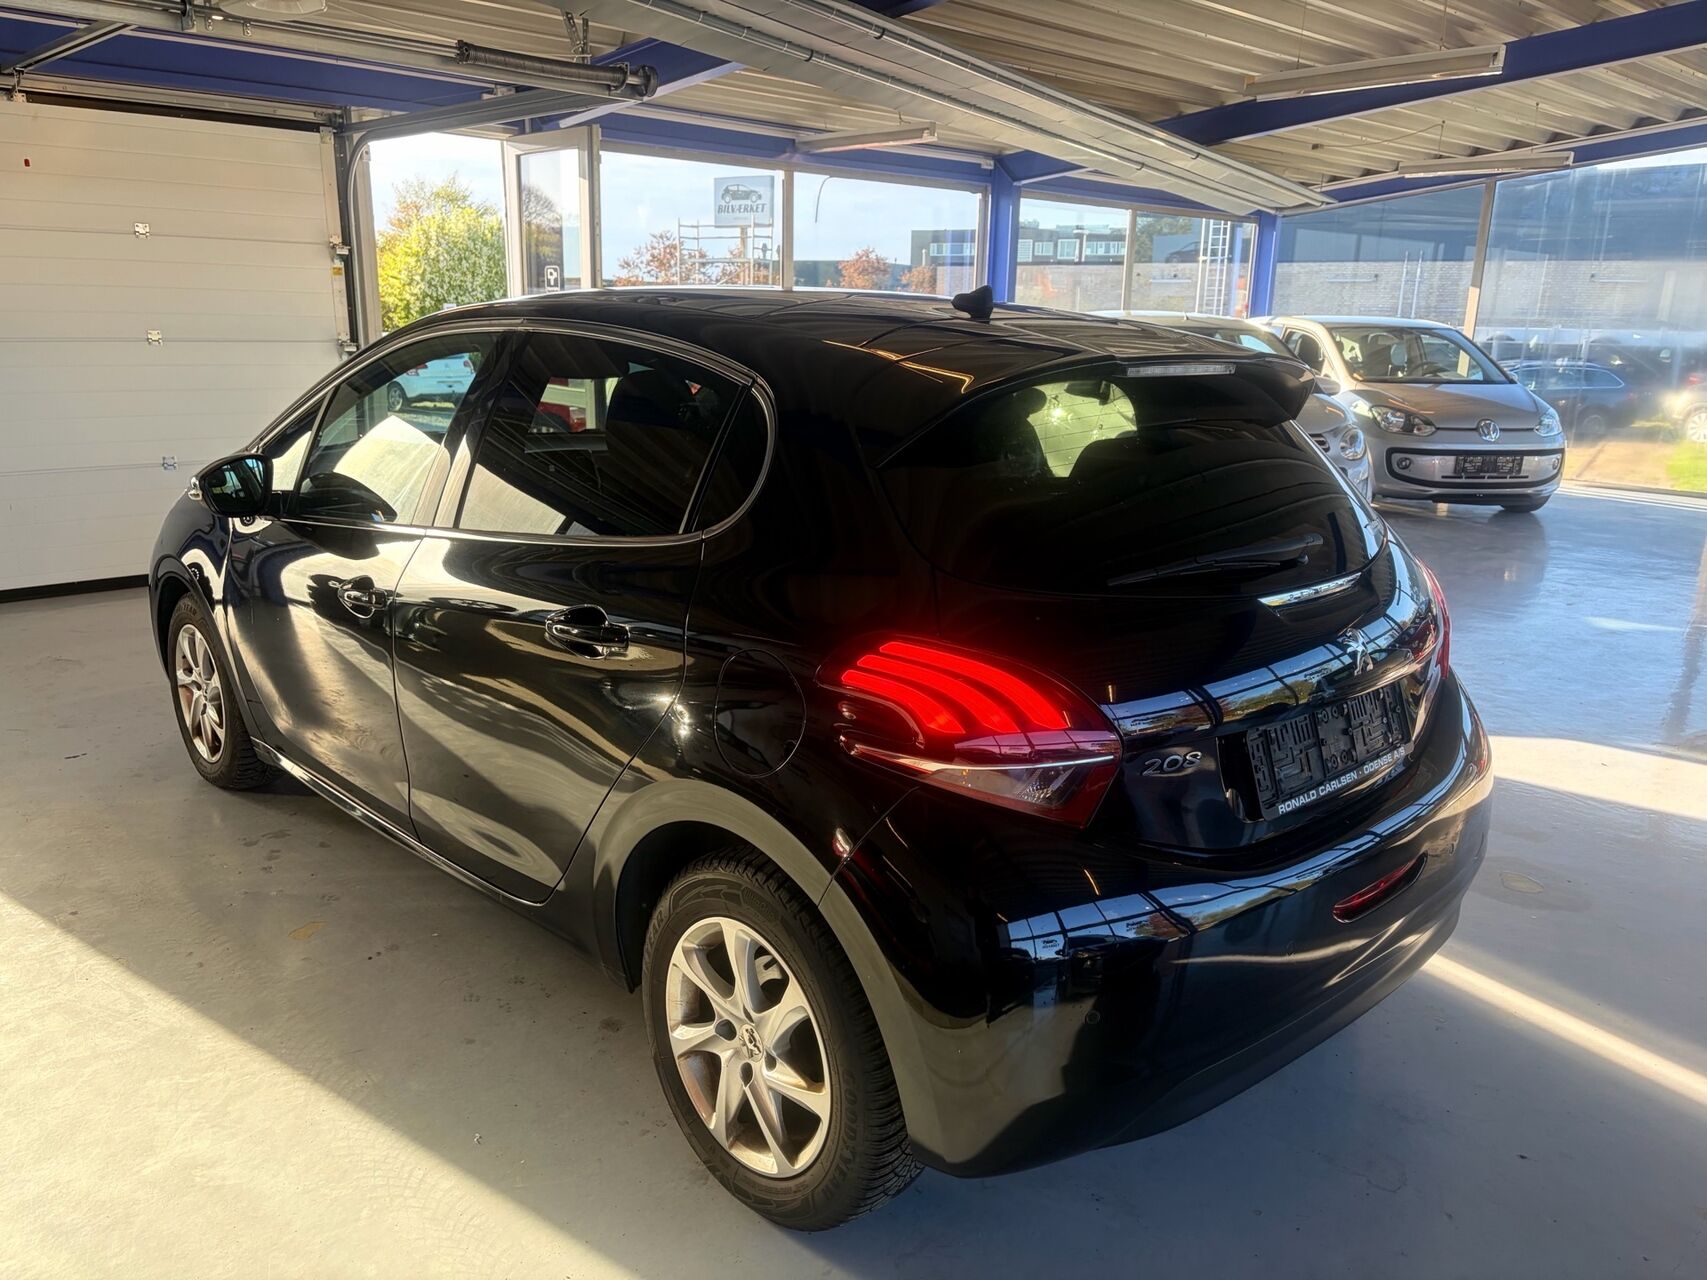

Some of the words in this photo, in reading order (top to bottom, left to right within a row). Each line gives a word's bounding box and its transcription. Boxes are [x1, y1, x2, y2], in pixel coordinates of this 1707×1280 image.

[717, 203, 767, 214] BILVÆRKET
[1142, 751, 1202, 777] 208
[1278, 790, 1317, 815] RONALD
[1318, 770, 1358, 796] CARLSEN
[1363, 753, 1393, 774] ODENSE
[1393, 746, 1406, 760] A/S
